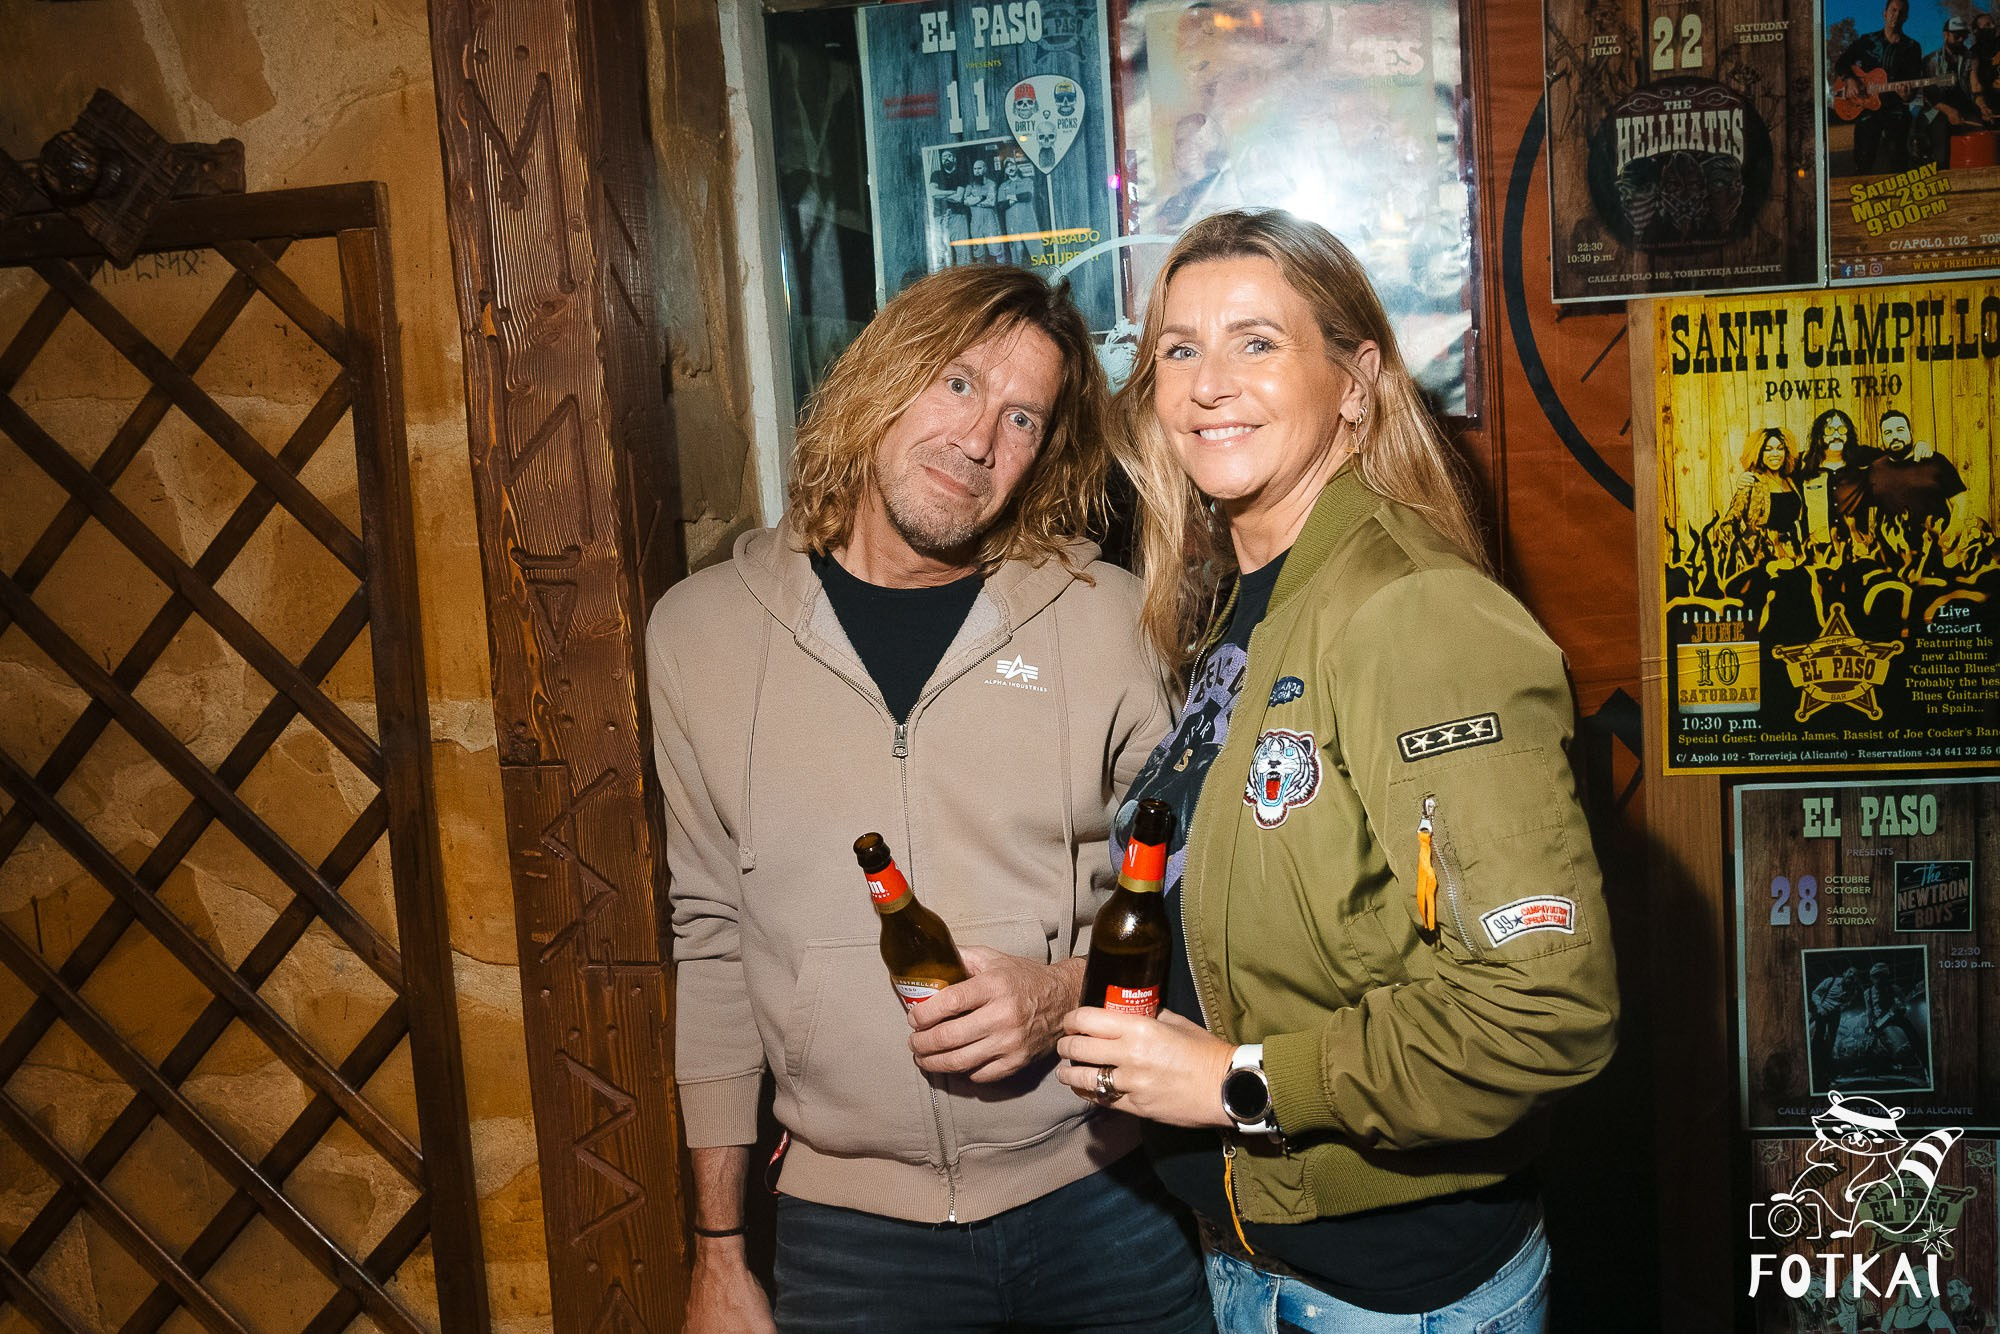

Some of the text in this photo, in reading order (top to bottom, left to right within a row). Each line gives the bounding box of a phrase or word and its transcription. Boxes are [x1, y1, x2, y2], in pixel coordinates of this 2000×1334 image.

[920, 0, 1042, 54] EL PASO
[1733, 20, 1789, 33] SATURDAY
[1594, 35, 1618, 47] JULY
[1652, 14, 1703, 71] 22
[1591, 46, 1621, 58] JULIO
[946, 78, 990, 134] 11
[1663, 100, 1692, 111] THE
[1015, 118, 1078, 132] DIRTY PICKS
[1615, 109, 1744, 177] HELLHATES
[1850, 161, 1938, 204] SATURDAY
[1851, 177, 1951, 224] MAY 28TH
[1577, 242, 1603, 252] 22:30
[1948, 235, 1969, 247] 102
[1567, 254, 1591, 264] 10:30
[1588, 274, 1618, 284] CALLE
[1619, 272, 1652, 282] APOLO
[1674, 267, 1732, 279] TORREVIEJA
[1734, 264, 1782, 275] ALICANTE
[1671, 296, 2000, 376] SANTI CAMPILLO
[1765, 378, 1842, 402] POWER
[1938, 605, 1970, 617] Live
[1691, 622, 1745, 643] JUNE
[1926, 623, 1982, 634] Concert
[1916, 636, 1994, 649] Featuring his
[1921, 651, 1988, 661] new album:
[1696, 648, 1740, 686] 10
[1800, 657, 1876, 682] EL PASO
[1008, 681, 1048, 693] INDUSTRIES
[1905, 677, 1955, 689] Probably
[1959, 677, 1977, 687] the
[1679, 687, 1758, 703] SATURDAY
[1912, 689, 1999, 701] Blues Guitarist
[1927, 703, 1984, 715] in Spain...
[1682, 716, 1761, 732] 10:30 p.m.
[1678, 734, 1718, 746] Special
[1722, 733, 1757, 744] Guest:
[1760, 731, 1798, 743] Oneida
[1843, 729, 1884, 740] Bassist
[1888, 729, 1900, 739] of
[1903, 729, 1923, 739] Joe
[1927, 727, 1972, 738] Cocker's
[1976, 726, 2000, 737] Ban
[1676, 753, 1687, 763] C/
[1690, 752, 1719, 764] Apolo
[1722, 752, 1739, 761] 102
[1748, 751, 1797, 762] Torrevieja
[1800, 749, 1848, 761] (Alicante)
[1858, 748, 1922, 758] Reservations
[1945, 747, 1961, 756] 641
[1965, 746, 1977, 755] 32
[1980, 746, 1992, 755] 55
[1802, 794, 1937, 838] EL PASO
[1847, 847, 1894, 856] PRESENTS
[1824, 876, 1870, 884] OCTUBRE
[1913, 863, 1945, 887] The
[1824, 886, 1871, 895] OCTOBER
[1897, 877, 1969, 912] NEWTRON
[1770, 875, 1818, 926] 28
[1826, 917, 1877, 926] SATURDAY
[1915, 903, 1953, 928] BOYS
[1493, 915, 1514, 934] 99
[1951, 947, 1981, 957] 22:30
[1938, 960, 1995, 970] 10:30 p.m.
[1121, 989, 1153, 999] Mahou
[1777, 1107, 1807, 1116] CALLE
[1927, 1106, 1974, 1115] ALICANTE
[1869, 1199, 1949, 1222] EL PASO
